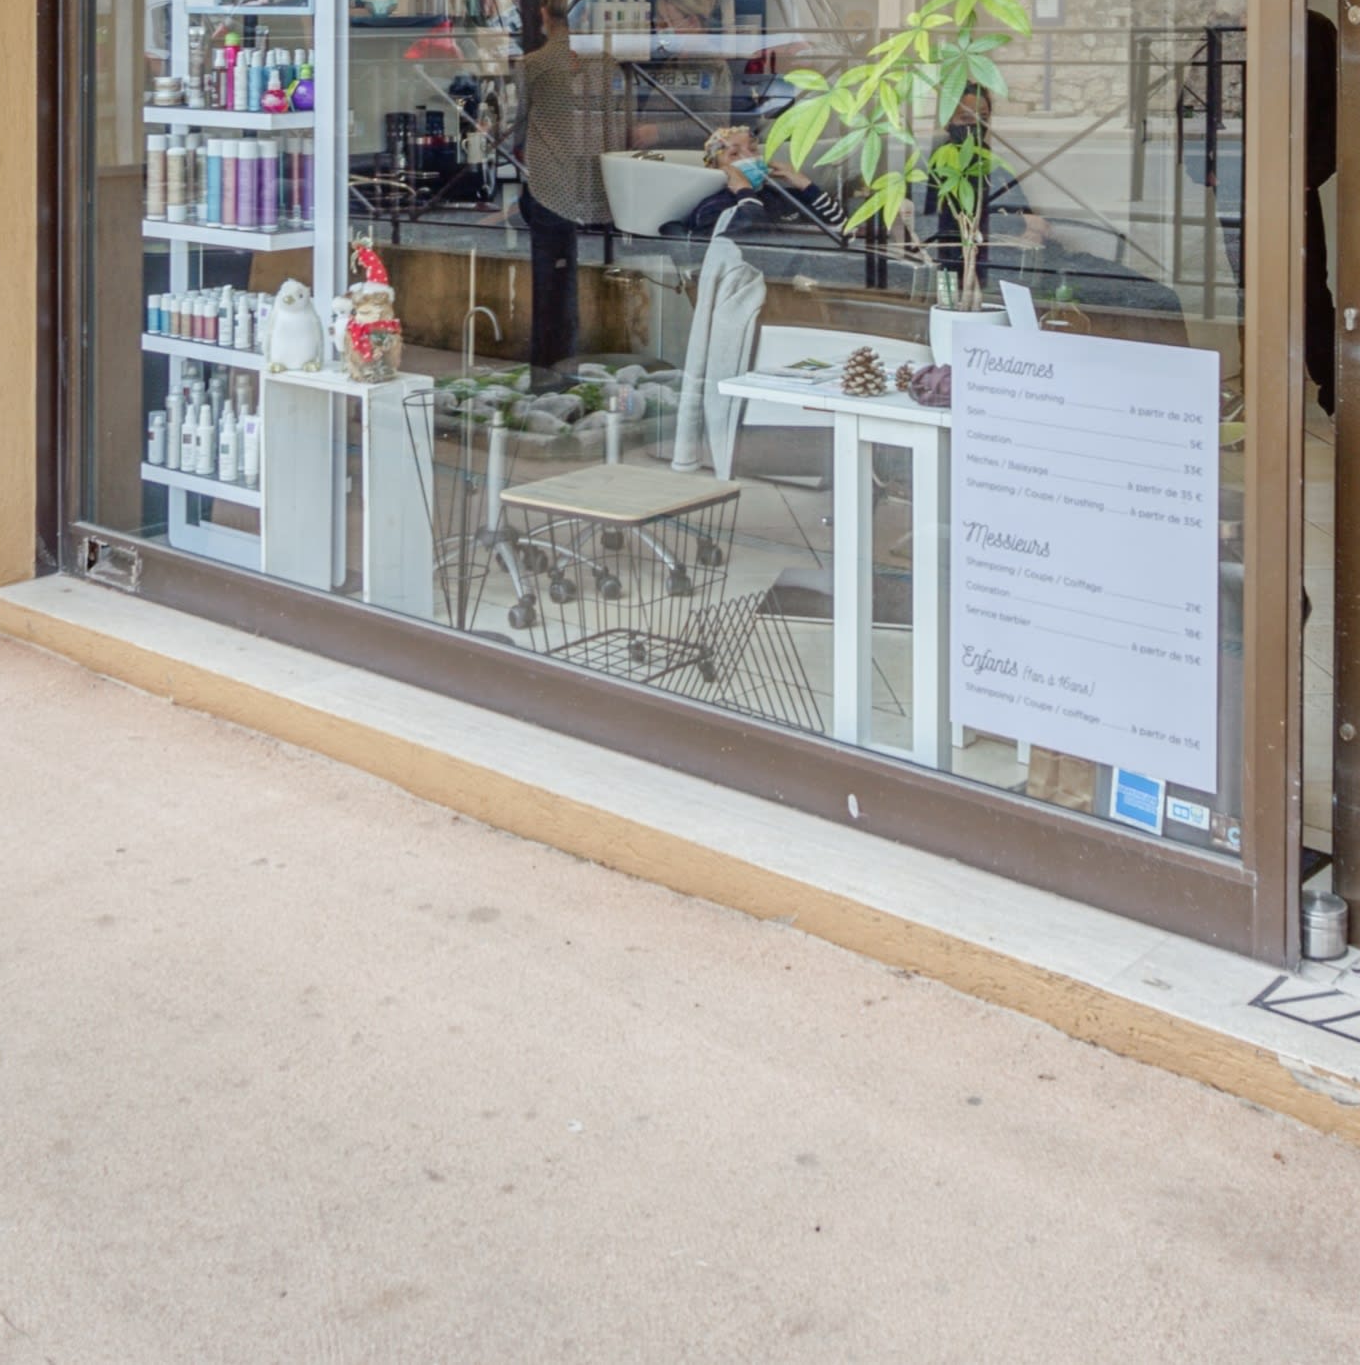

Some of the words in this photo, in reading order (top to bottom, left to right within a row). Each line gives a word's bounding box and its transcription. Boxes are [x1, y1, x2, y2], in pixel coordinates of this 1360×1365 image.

[963, 346, 1055, 379] Mesdames
[1138, 407, 1166, 419] partir
[966, 429, 1012, 445] Coloration
[1138, 510, 1165, 521] partir
[962, 521, 1050, 558] Messieurs
[966, 580, 1011, 596] Coloration
[961, 643, 1018, 677] Enfants
[1140, 645, 1167, 659] partir
[1139, 728, 1166, 741] partir
